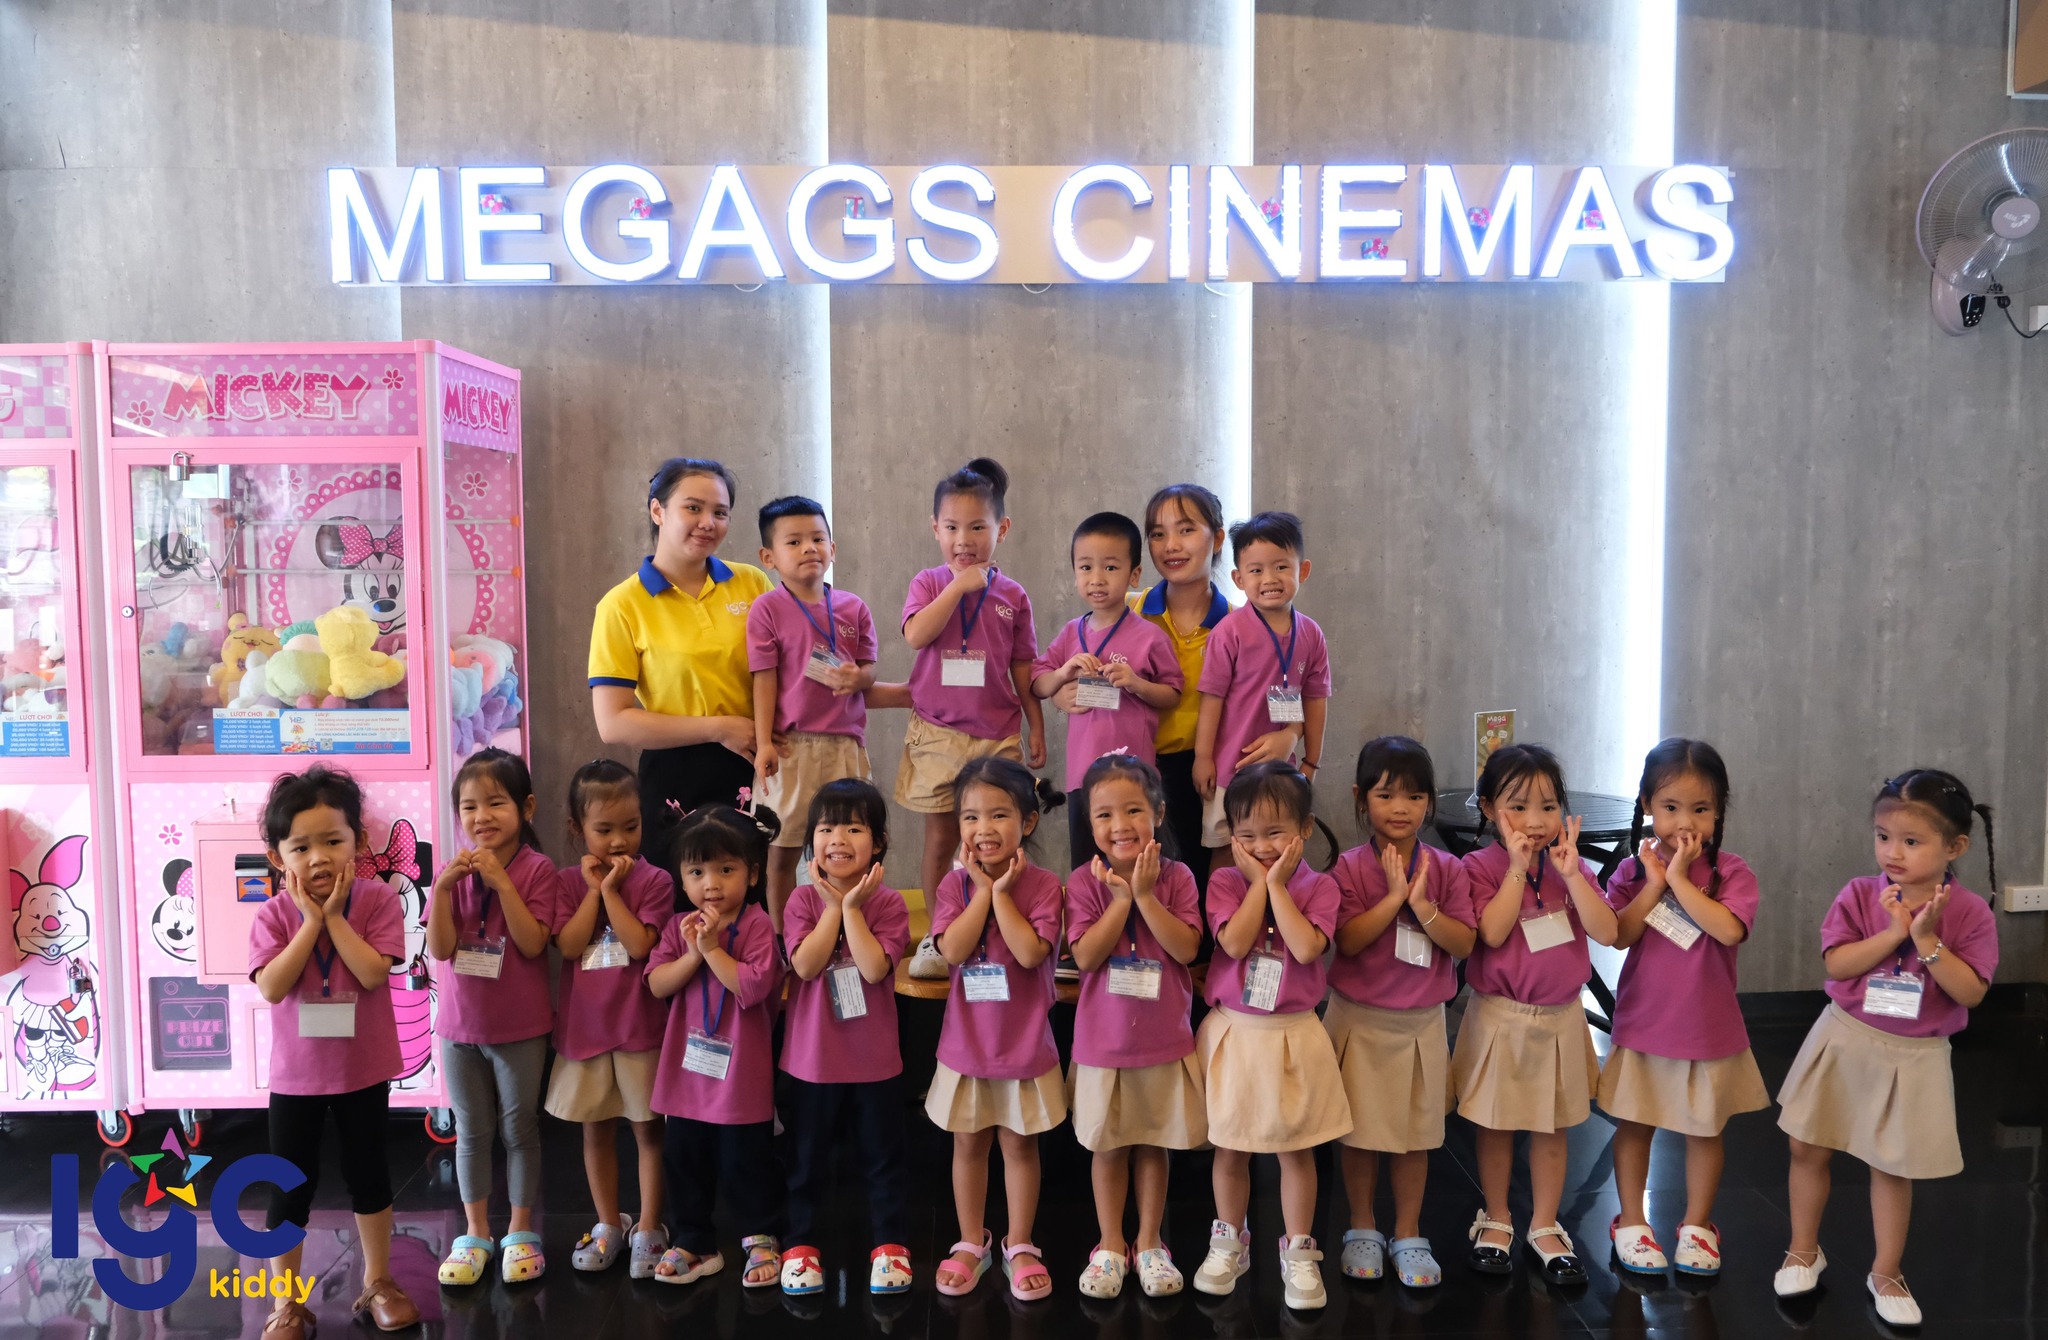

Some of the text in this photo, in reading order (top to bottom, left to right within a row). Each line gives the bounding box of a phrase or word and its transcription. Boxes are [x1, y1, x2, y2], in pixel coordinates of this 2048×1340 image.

[327, 162, 1736, 284] MEGAGS CINEMAS
[162, 369, 372, 423] MICKEY
[442, 381, 513, 435] MICKEY
[166, 1019, 223, 1034] PRIZE
[177, 1034, 215, 1048] OUT
